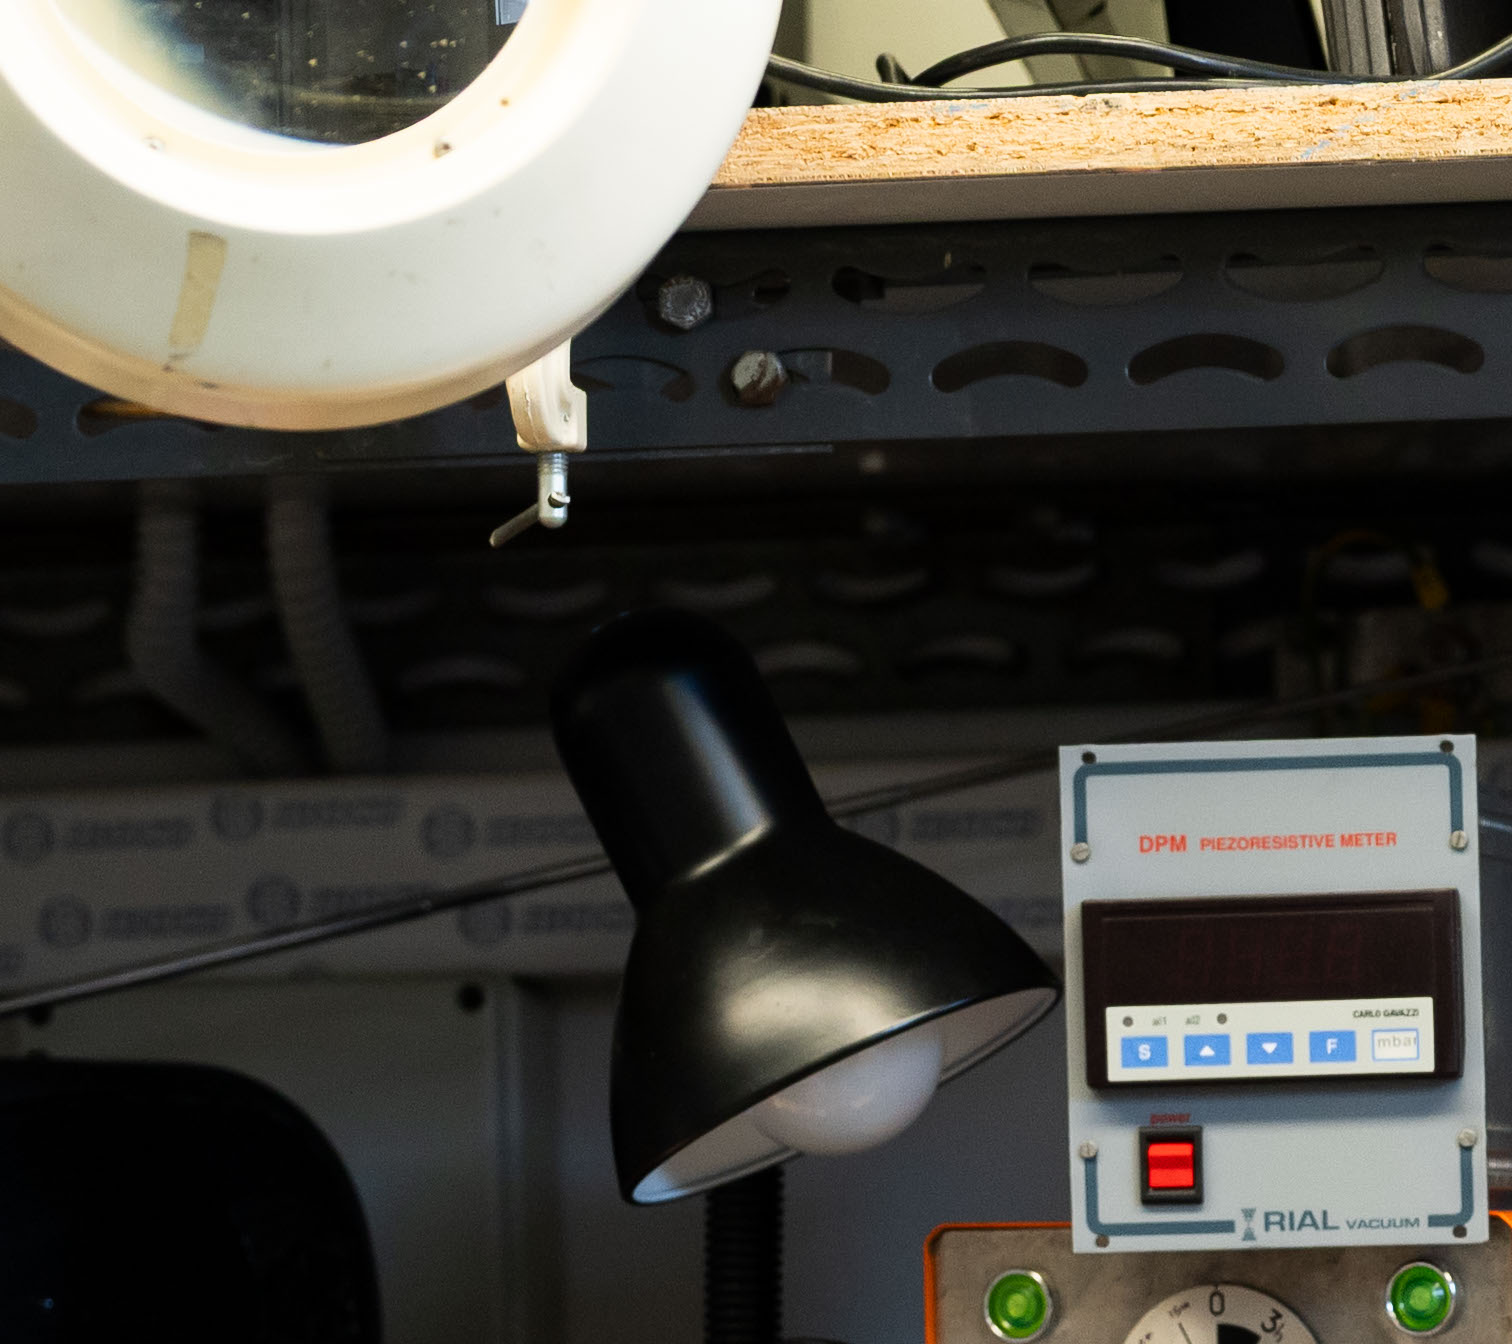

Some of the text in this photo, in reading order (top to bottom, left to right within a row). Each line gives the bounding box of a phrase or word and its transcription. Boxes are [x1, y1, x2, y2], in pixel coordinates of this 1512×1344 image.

[1139, 831, 1397, 853] DPM PIEZORESISTIVE METER
[1138, 1038, 1338, 1061] S F
[1264, 1209, 1420, 1233] RIAL VACUUM
